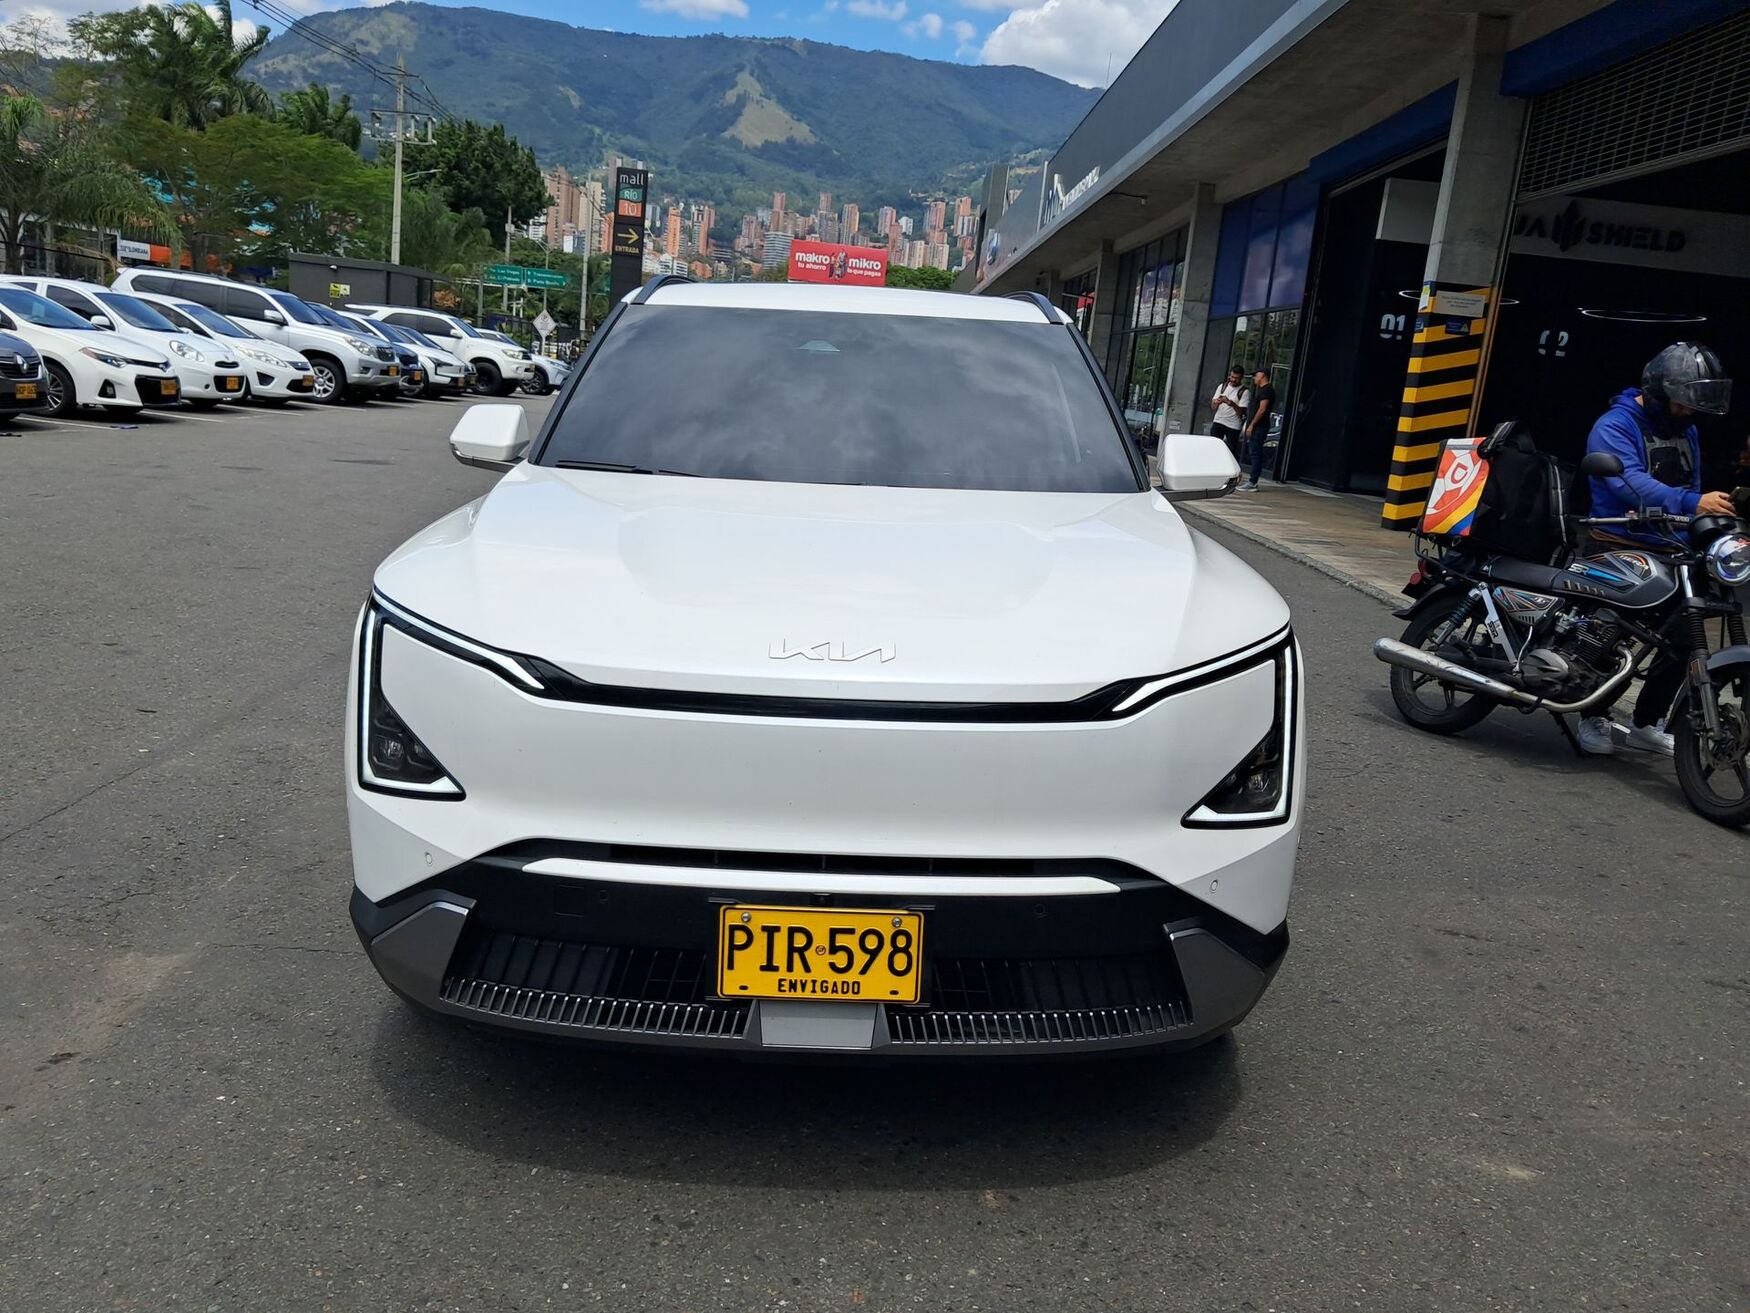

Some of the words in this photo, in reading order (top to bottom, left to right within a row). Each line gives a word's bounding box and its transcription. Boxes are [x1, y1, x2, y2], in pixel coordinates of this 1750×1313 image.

[620, 173, 644, 185] mall
[623, 203, 637, 216] 10
[1586, 221, 1687, 253] SHIELD
[615, 245, 640, 254] ENTRADA
[795, 251, 830, 264] makro
[848, 258, 881, 270] mikro
[805, 262, 827, 271] ahorro
[863, 270, 881, 278] pagas
[1379, 313, 1406, 340] 01
[768, 637, 897, 664] KIA
[726, 924, 814, 973] PIR
[828, 927, 913, 977] 598
[777, 978, 861, 995] ENVIGADO
